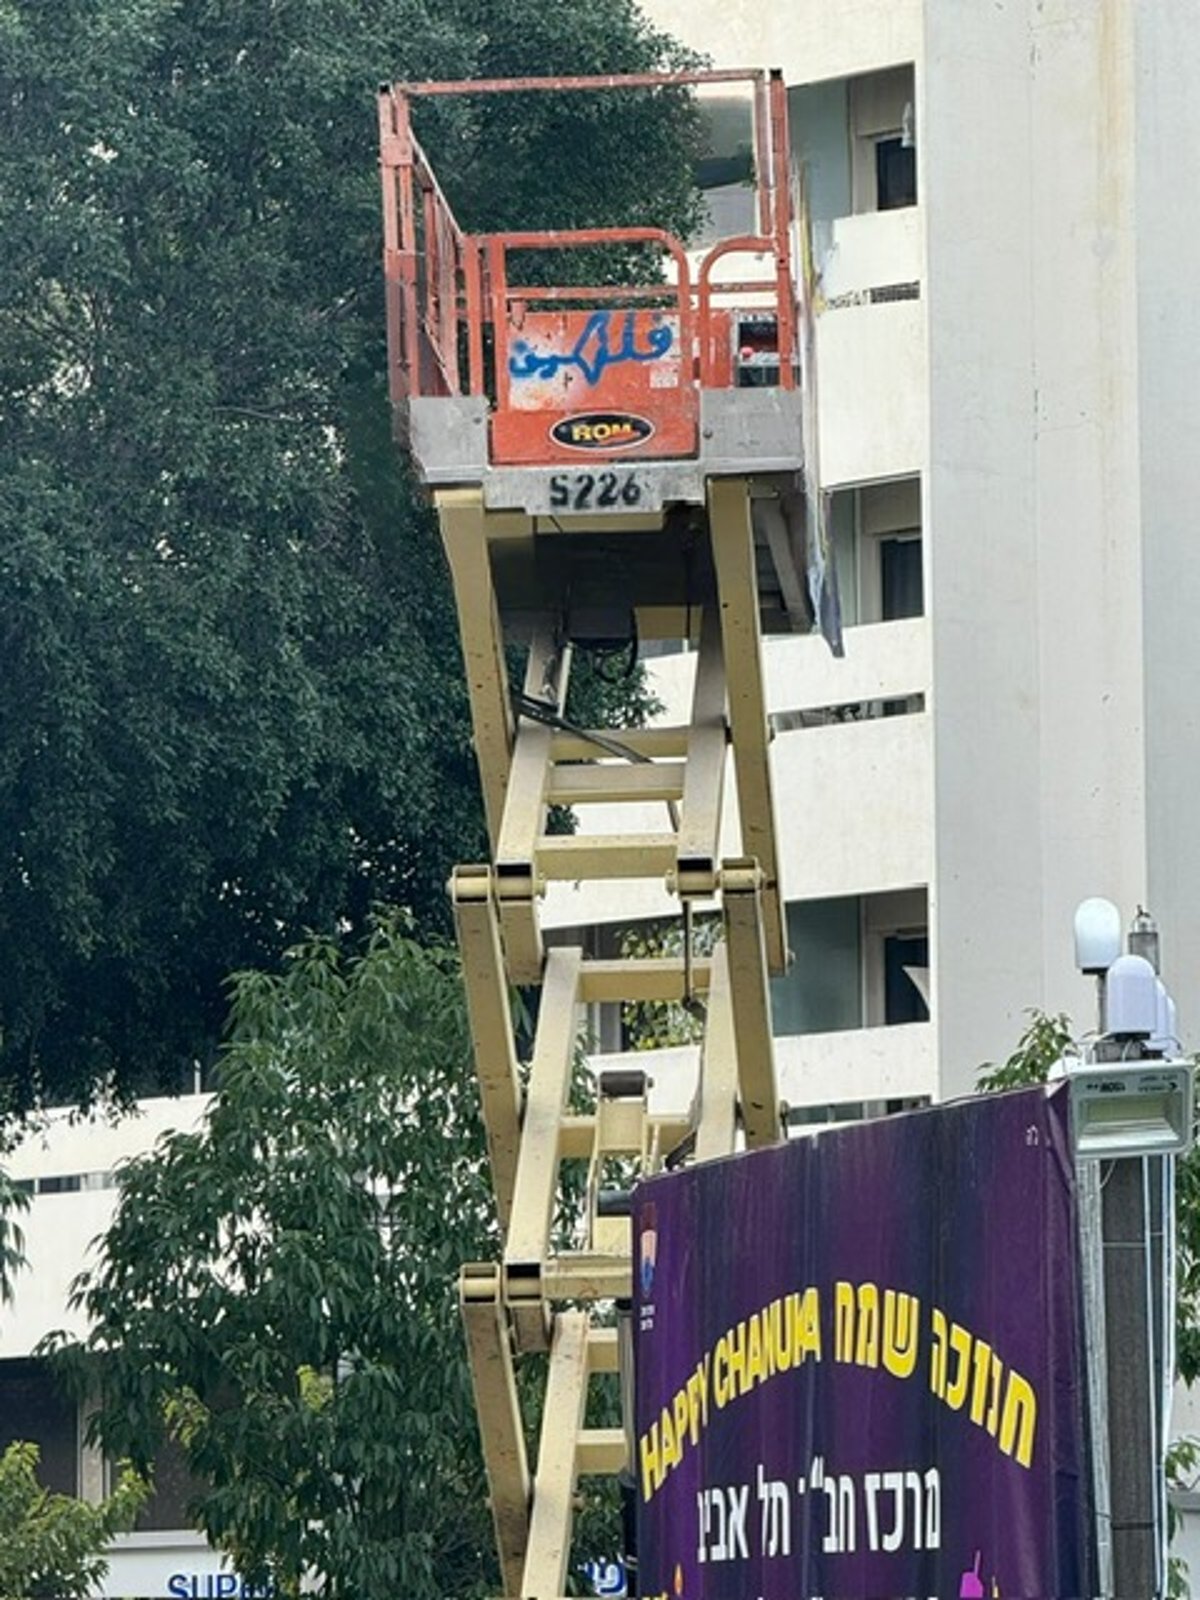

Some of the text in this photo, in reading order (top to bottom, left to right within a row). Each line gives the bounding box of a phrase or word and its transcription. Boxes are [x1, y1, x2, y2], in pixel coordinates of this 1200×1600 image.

[550, 471, 641, 510] S226
[834, 1280, 1037, 1469] חנוכה שמח
[639, 1352, 710, 1504] HAPPY
[757, 1464, 790, 1558] תל
[864, 1466, 941, 1552] מרכז
